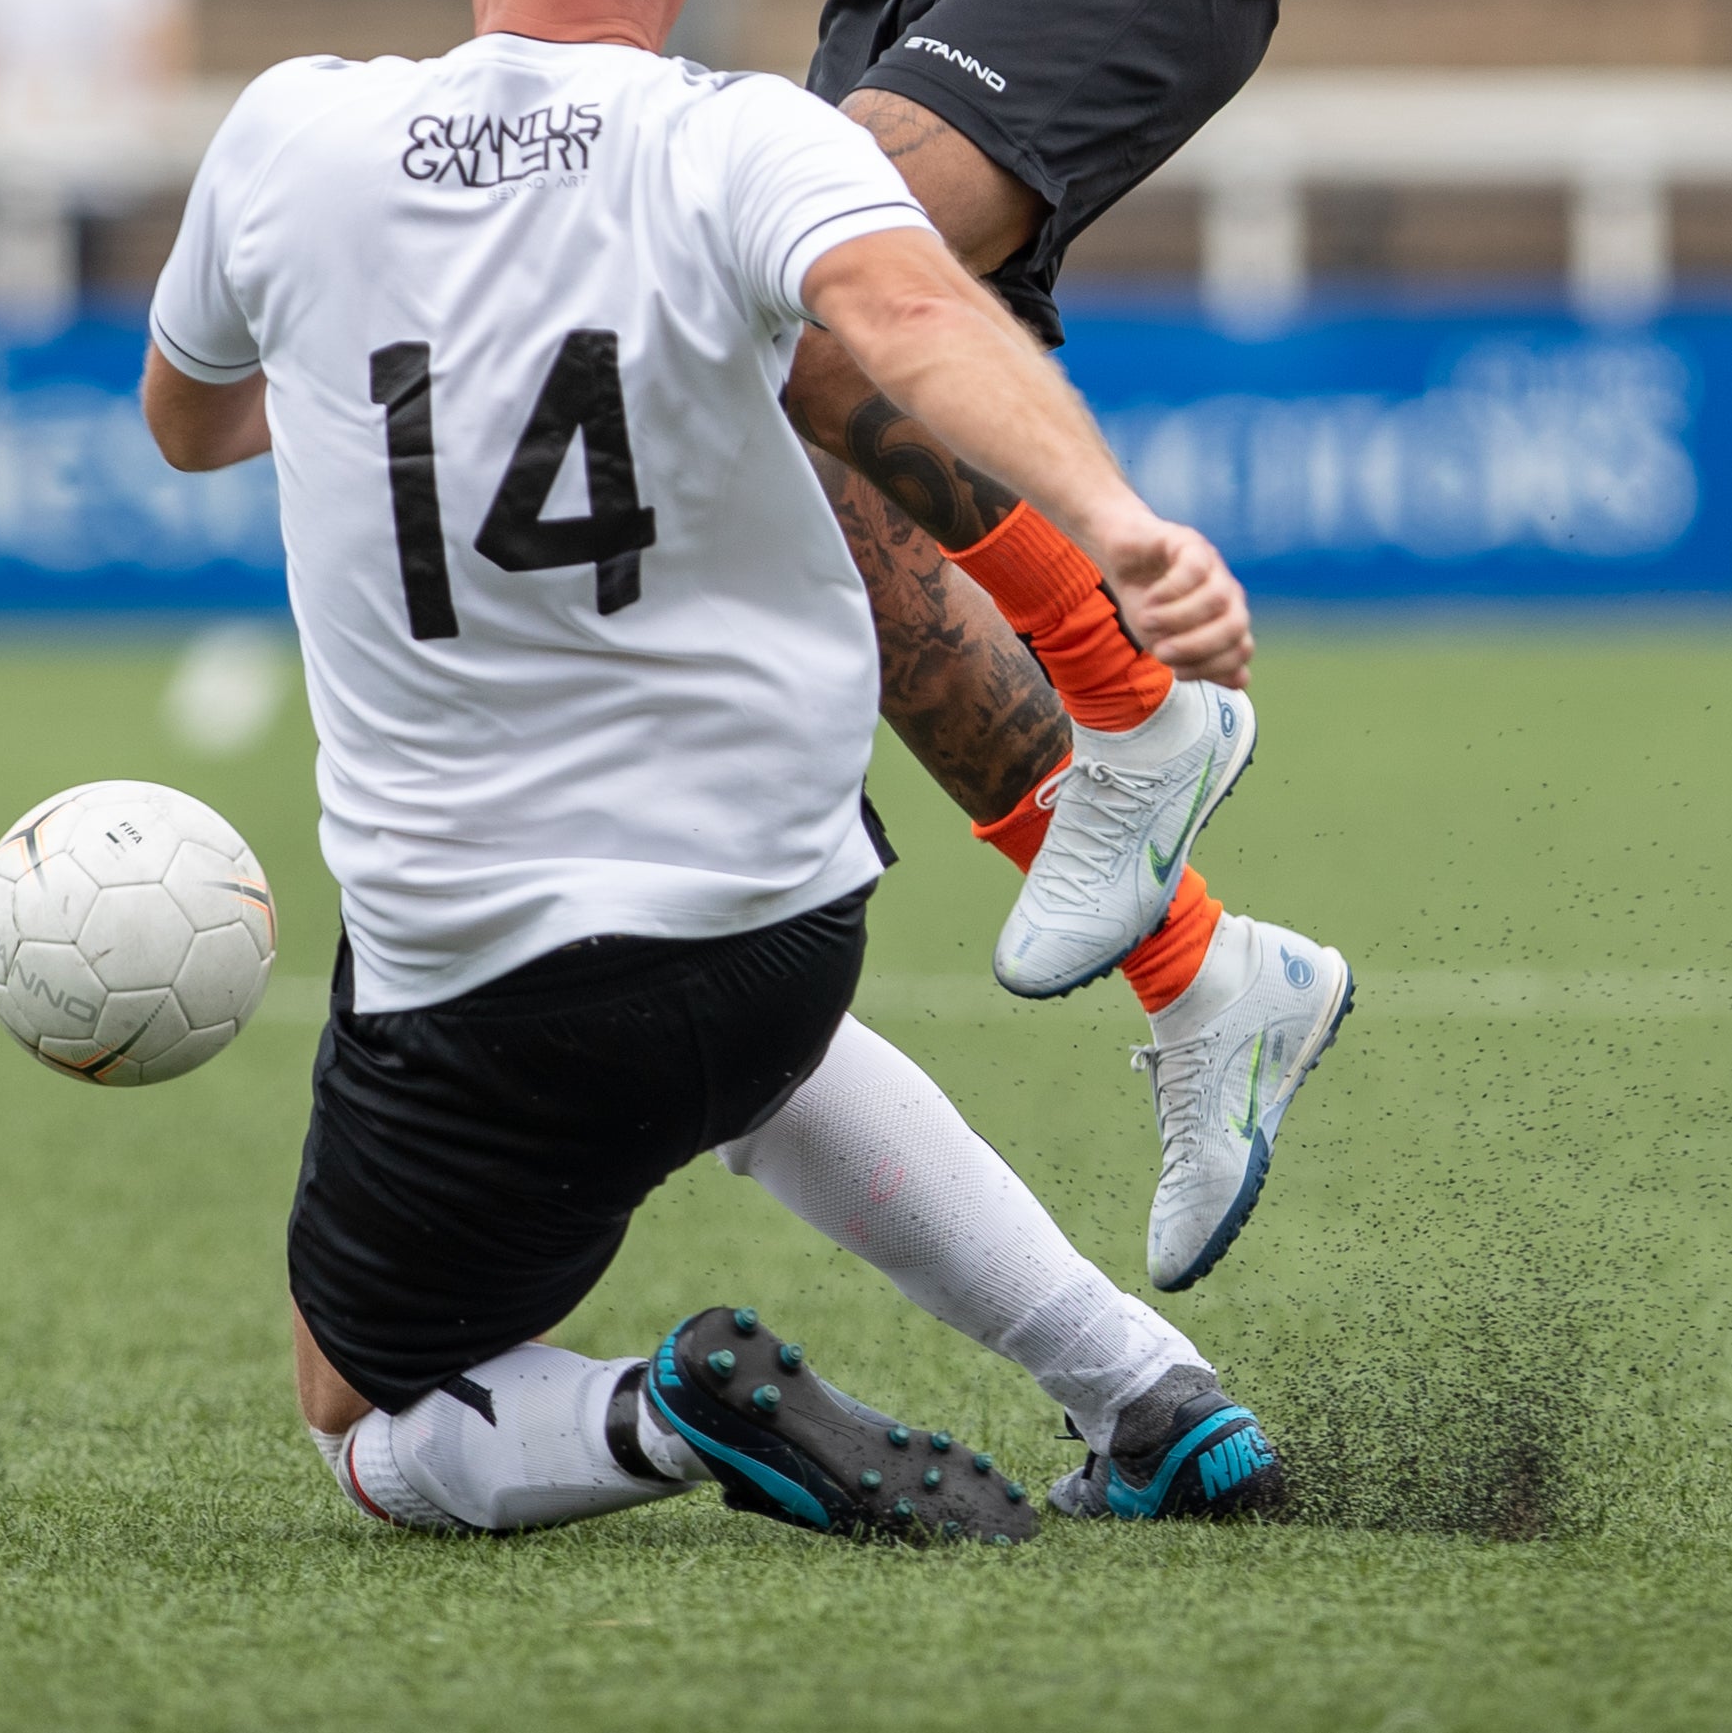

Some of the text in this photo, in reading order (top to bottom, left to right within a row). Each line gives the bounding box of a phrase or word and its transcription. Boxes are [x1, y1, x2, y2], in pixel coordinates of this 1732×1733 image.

[904, 36, 1007, 92] STANNO
[555, 174, 589, 189] ART
[369, 328, 657, 641] 14
[119, 821, 143, 844] FIFA
